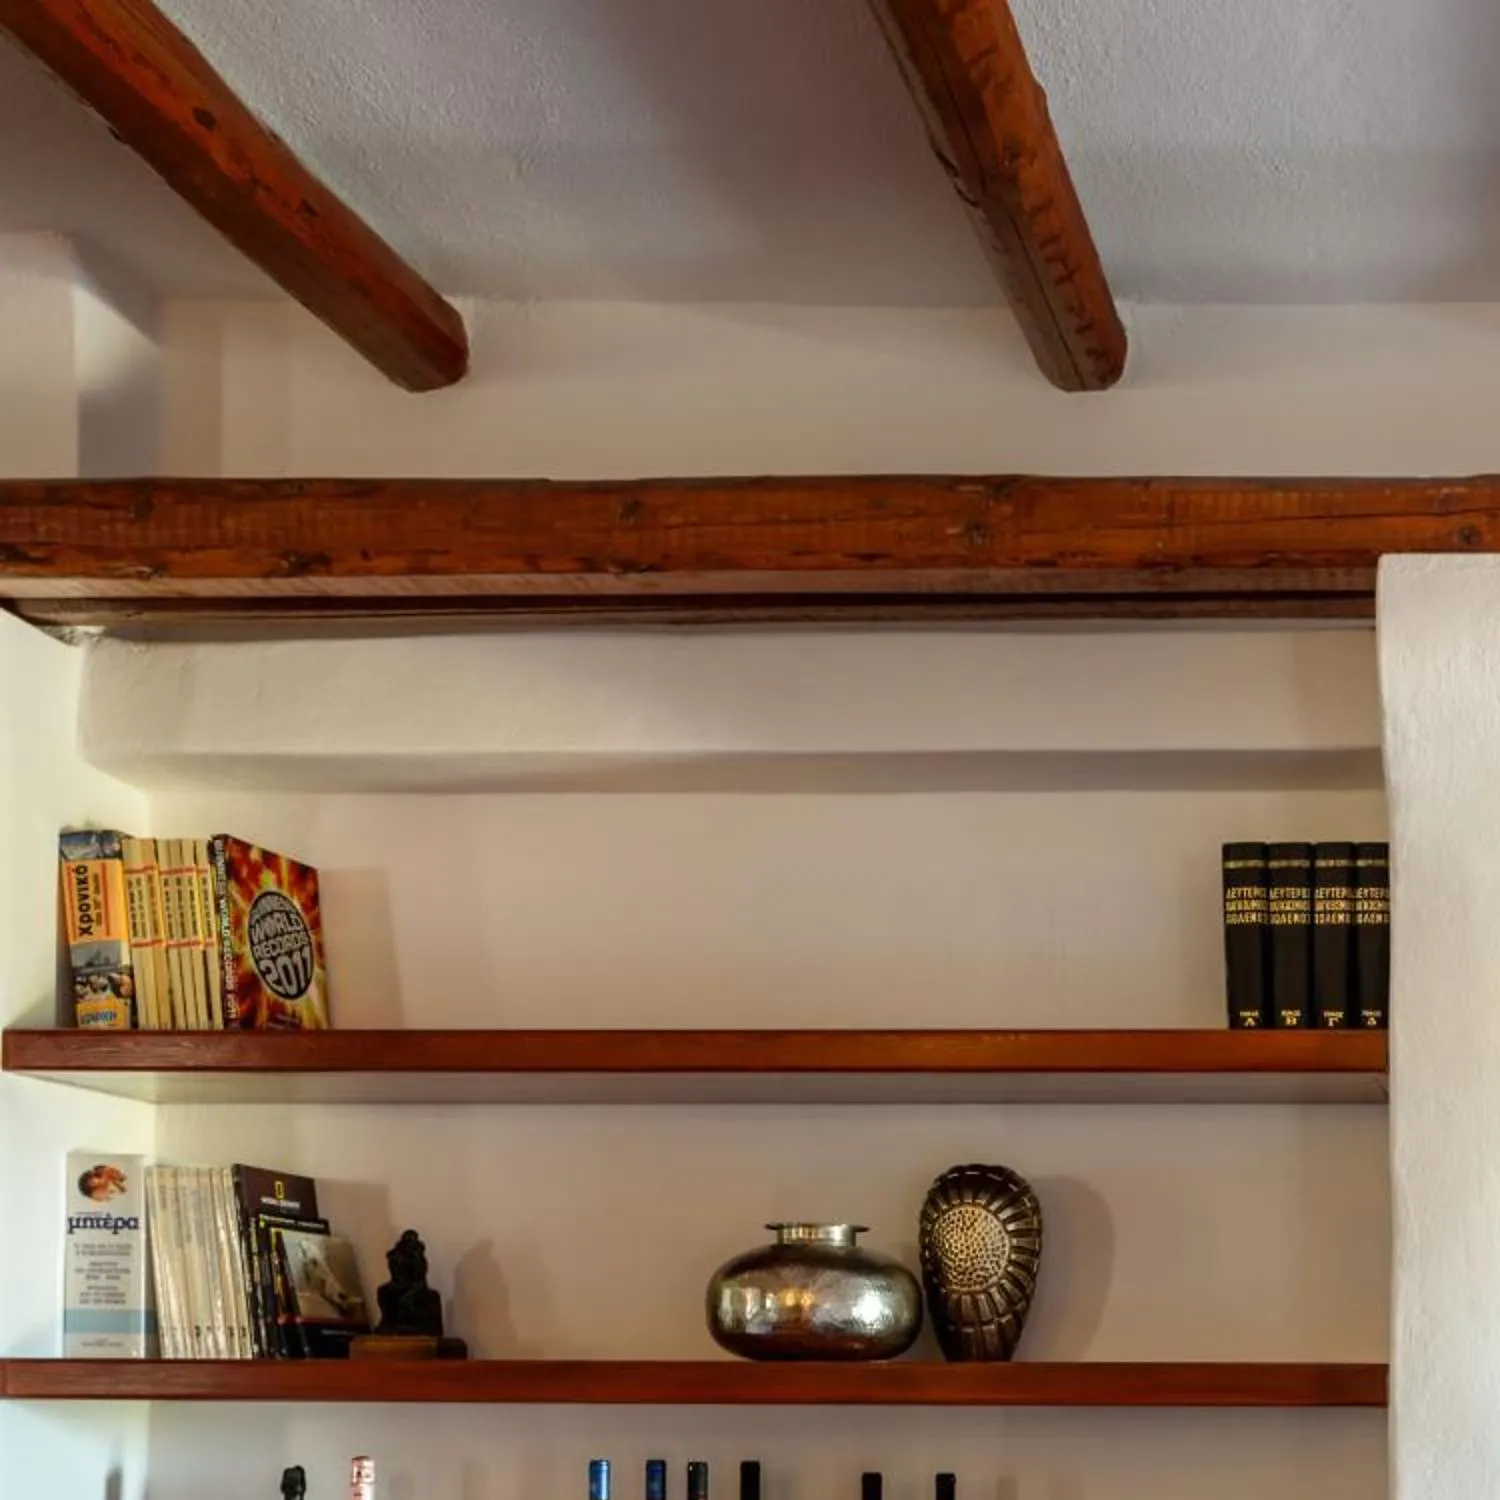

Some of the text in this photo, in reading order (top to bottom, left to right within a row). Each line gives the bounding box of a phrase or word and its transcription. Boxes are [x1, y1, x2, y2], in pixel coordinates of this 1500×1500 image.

[252, 912, 303, 944] WORLD
[259, 946, 311, 995] 2011
[67, 1212, 139, 1235] μητέρα
